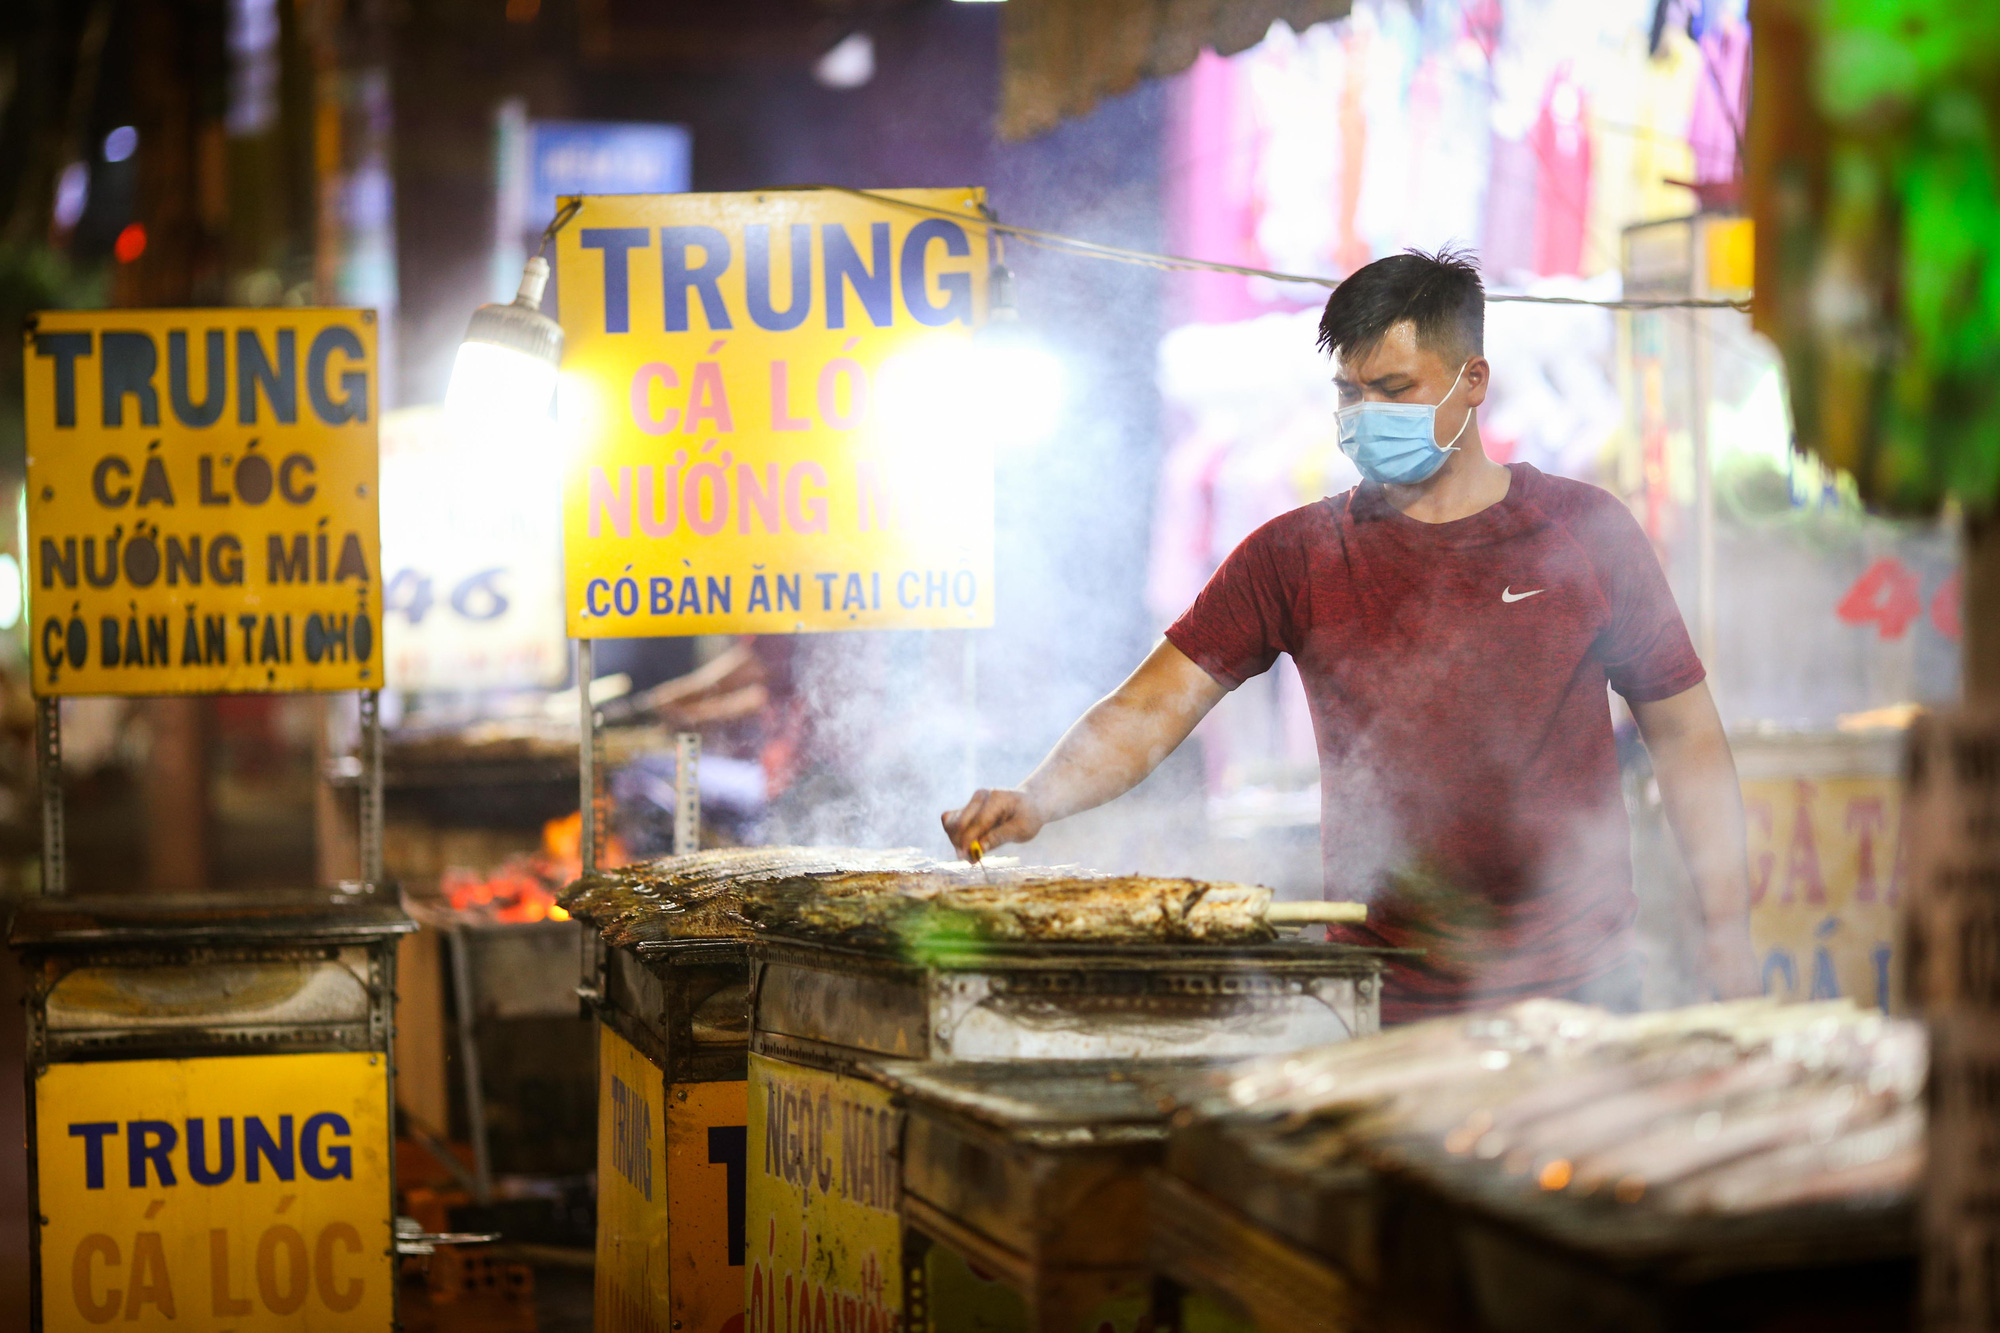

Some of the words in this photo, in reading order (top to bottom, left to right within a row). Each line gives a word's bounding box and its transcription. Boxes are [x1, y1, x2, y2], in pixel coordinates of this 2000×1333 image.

[580, 218, 973, 334] TRUNG
[34, 325, 369, 429] TRUNG
[630, 339, 735, 435] CÁ
[92, 439, 175, 508] CÁ
[198, 438, 317, 507] LÓC
[587, 438, 830, 539] NƯỚNG
[40, 520, 245, 589] NƯỚNG
[267, 516, 370, 586] MÍA
[585, 563, 640, 617] CÓ
[649, 558, 732, 616] BÀN
[747, 563, 801, 613] ĂN
[815, 571, 881, 620] TẠI
[42, 601, 88, 670] CÓ
[101, 601, 169, 667] BÀN
[181, 603, 227, 665] ĂN
[239, 613, 293, 682] TẠI
[68, 1111, 353, 1190] TRUNG
[764, 1080, 833, 1209] NGỌC
[71, 1199, 177, 1325] CÁ
[209, 1194, 365, 1318] LÓC
